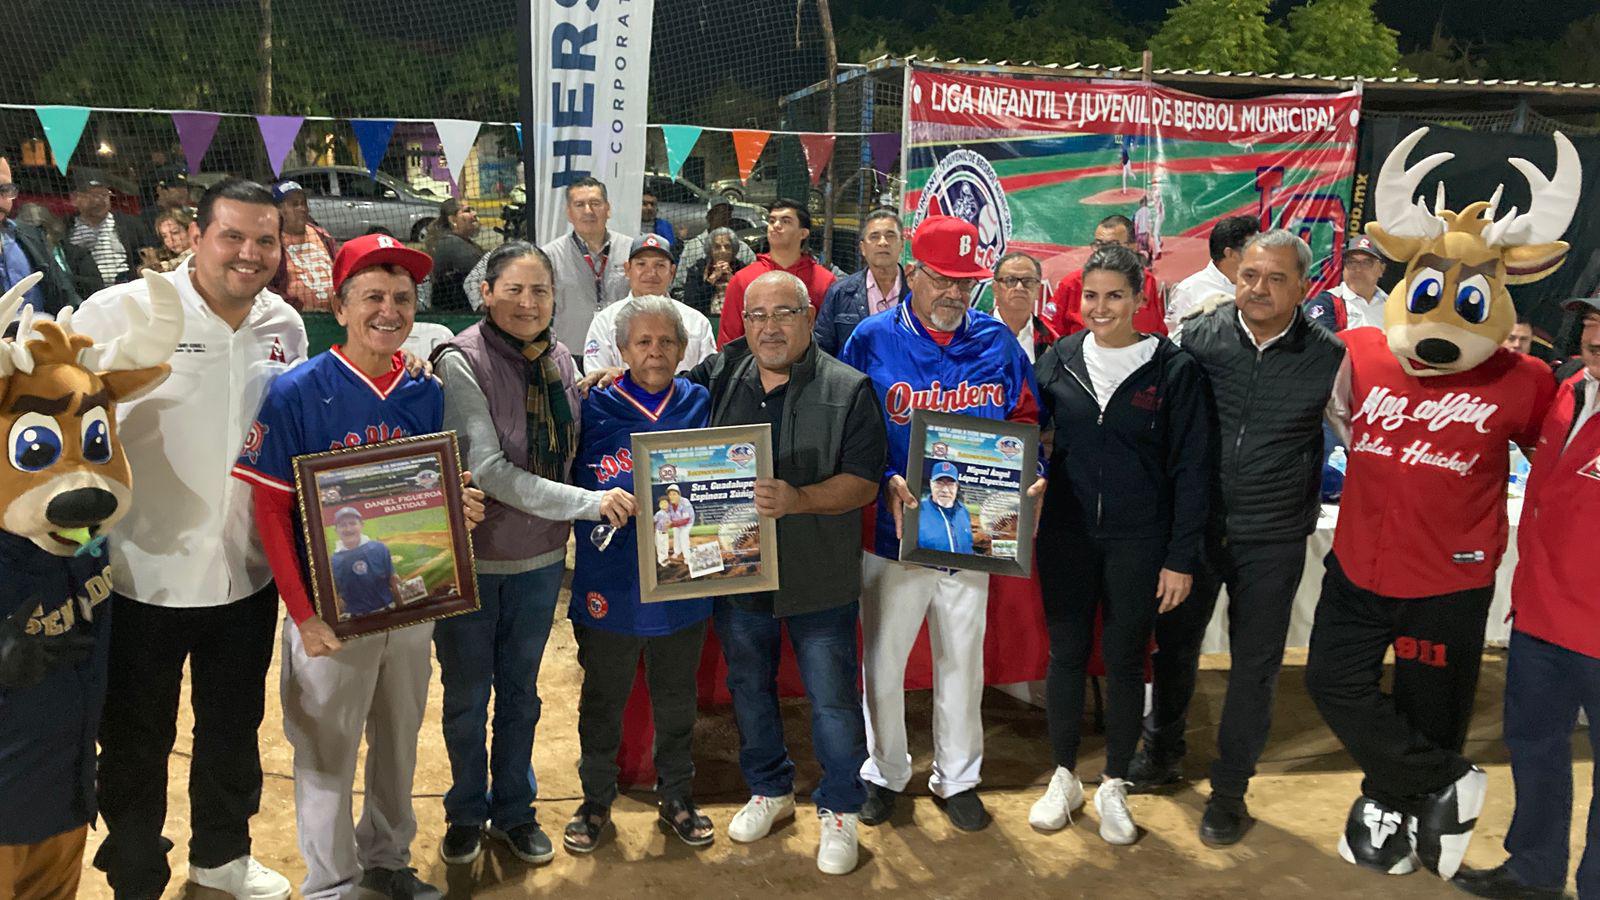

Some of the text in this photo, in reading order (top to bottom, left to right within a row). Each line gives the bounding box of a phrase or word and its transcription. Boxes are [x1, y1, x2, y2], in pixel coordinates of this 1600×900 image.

[931, 81, 1337, 133] LIGA INFANTIL Y JUVENIL DE BEISBOL MUNICIPAL
[959, 235, 972, 256] B
[363, 490, 443, 510] DANIEL FIGUEROA
